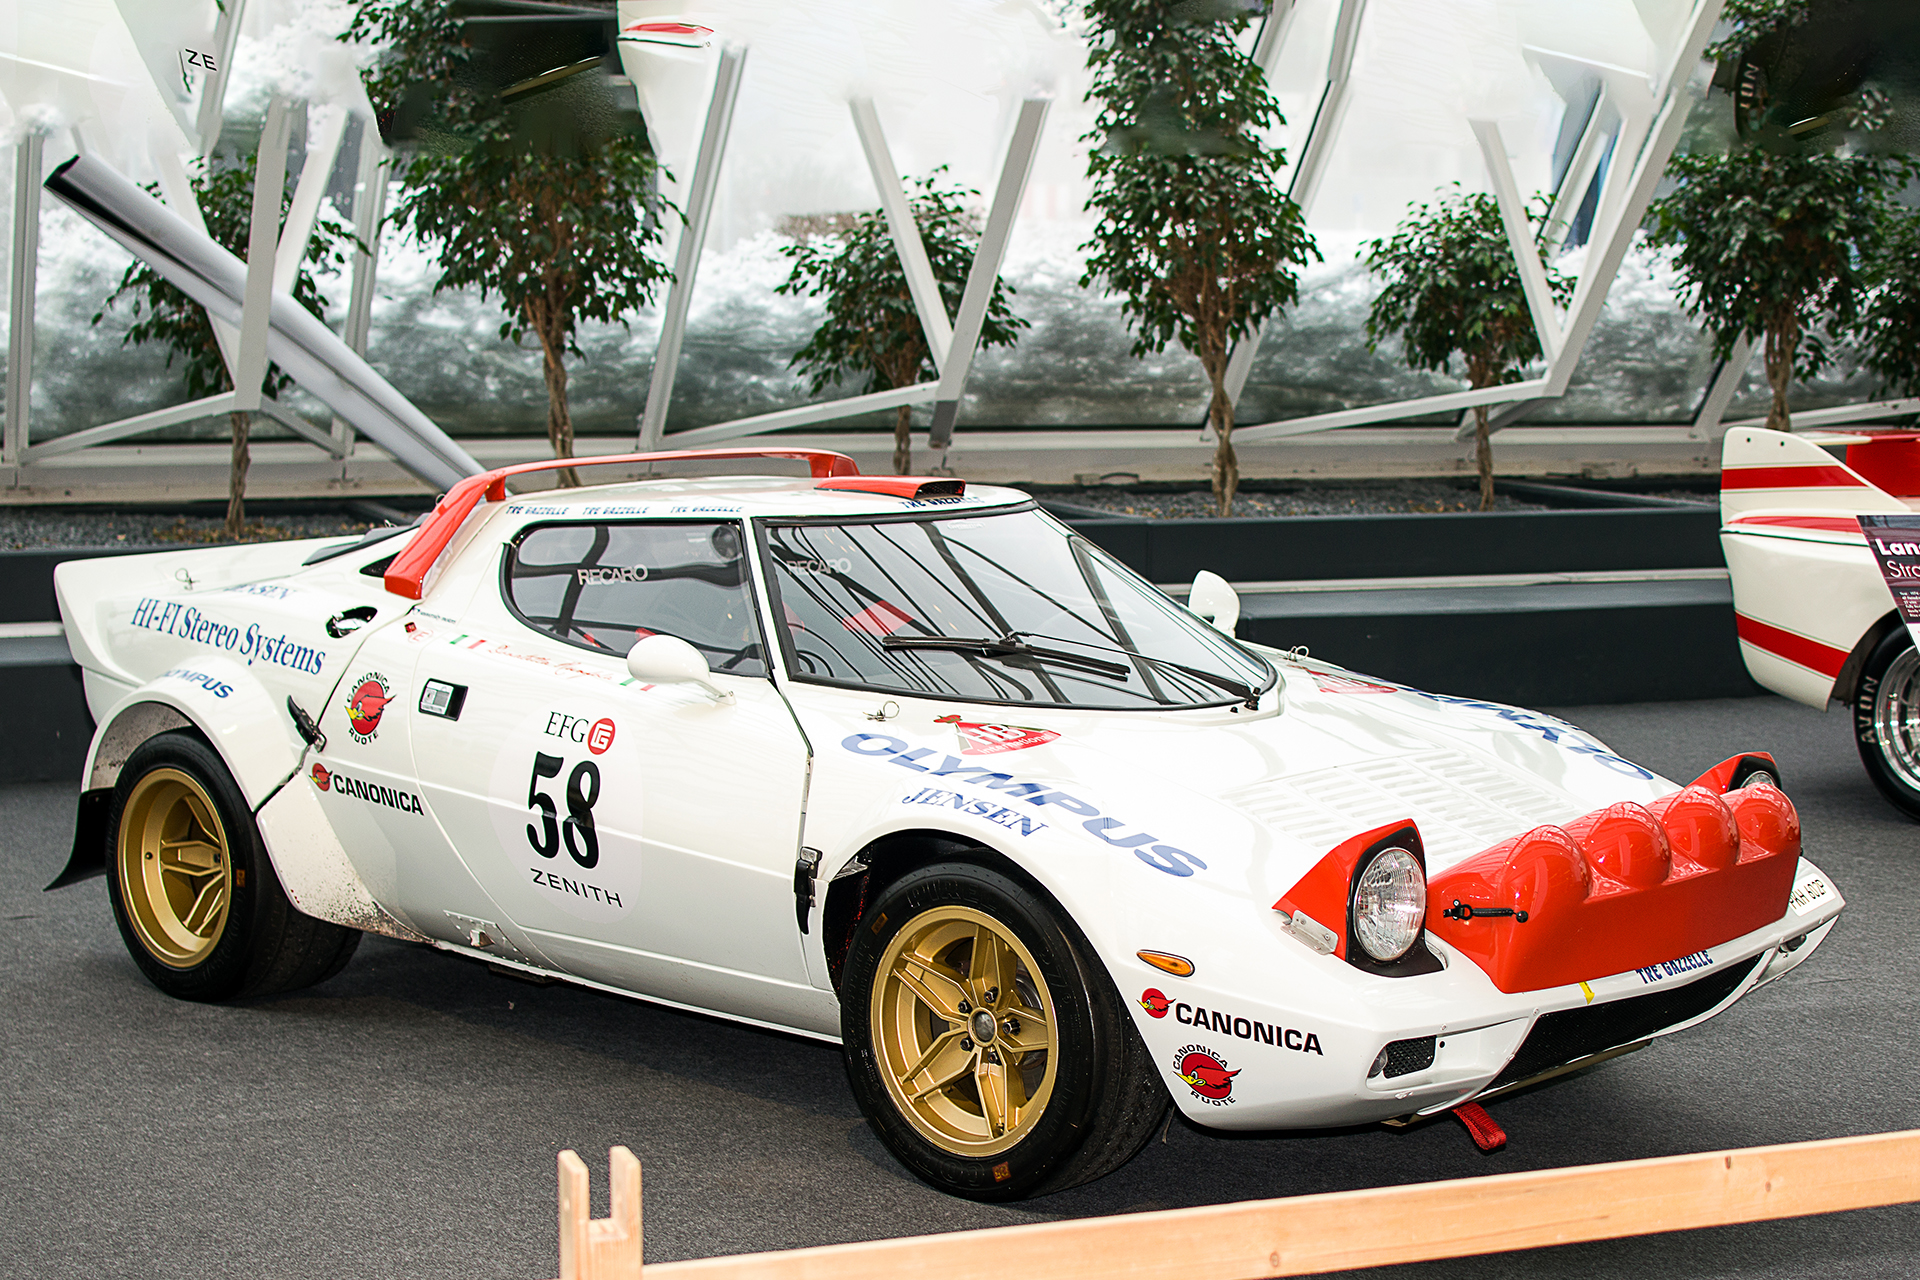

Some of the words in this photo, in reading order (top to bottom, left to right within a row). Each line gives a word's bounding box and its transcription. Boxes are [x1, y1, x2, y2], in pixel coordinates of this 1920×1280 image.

[1875, 538, 1920, 555] Lan
[577, 563, 649, 586] RECARO
[786, 557, 852, 576] RECARO
[130, 597, 184, 636] HI-FI
[178, 606, 239, 651] Stereo
[238, 622, 326, 676] Systems
[346, 671, 391, 703] CANONICA
[1858, 675, 1879, 744] AVON
[348, 726, 380, 746] RUOTE
[543, 711, 589, 743] EFG
[955, 723, 1028, 747] HB
[332, 773, 425, 816] CANONICA
[526, 751, 601, 869] 58
[841, 733, 1208, 878] OLYMPUS
[902, 787, 1049, 837] JENSEN
[530, 867, 623, 908] ZENITH
[1635, 964, 1663, 984] TRE
[1660, 949, 1714, 977] GAZZELLE
[1175, 1003, 1324, 1056] CANONICA
[1172, 1044, 1229, 1070] CANONICA
[1190, 1090, 1237, 1107] RUOTE
